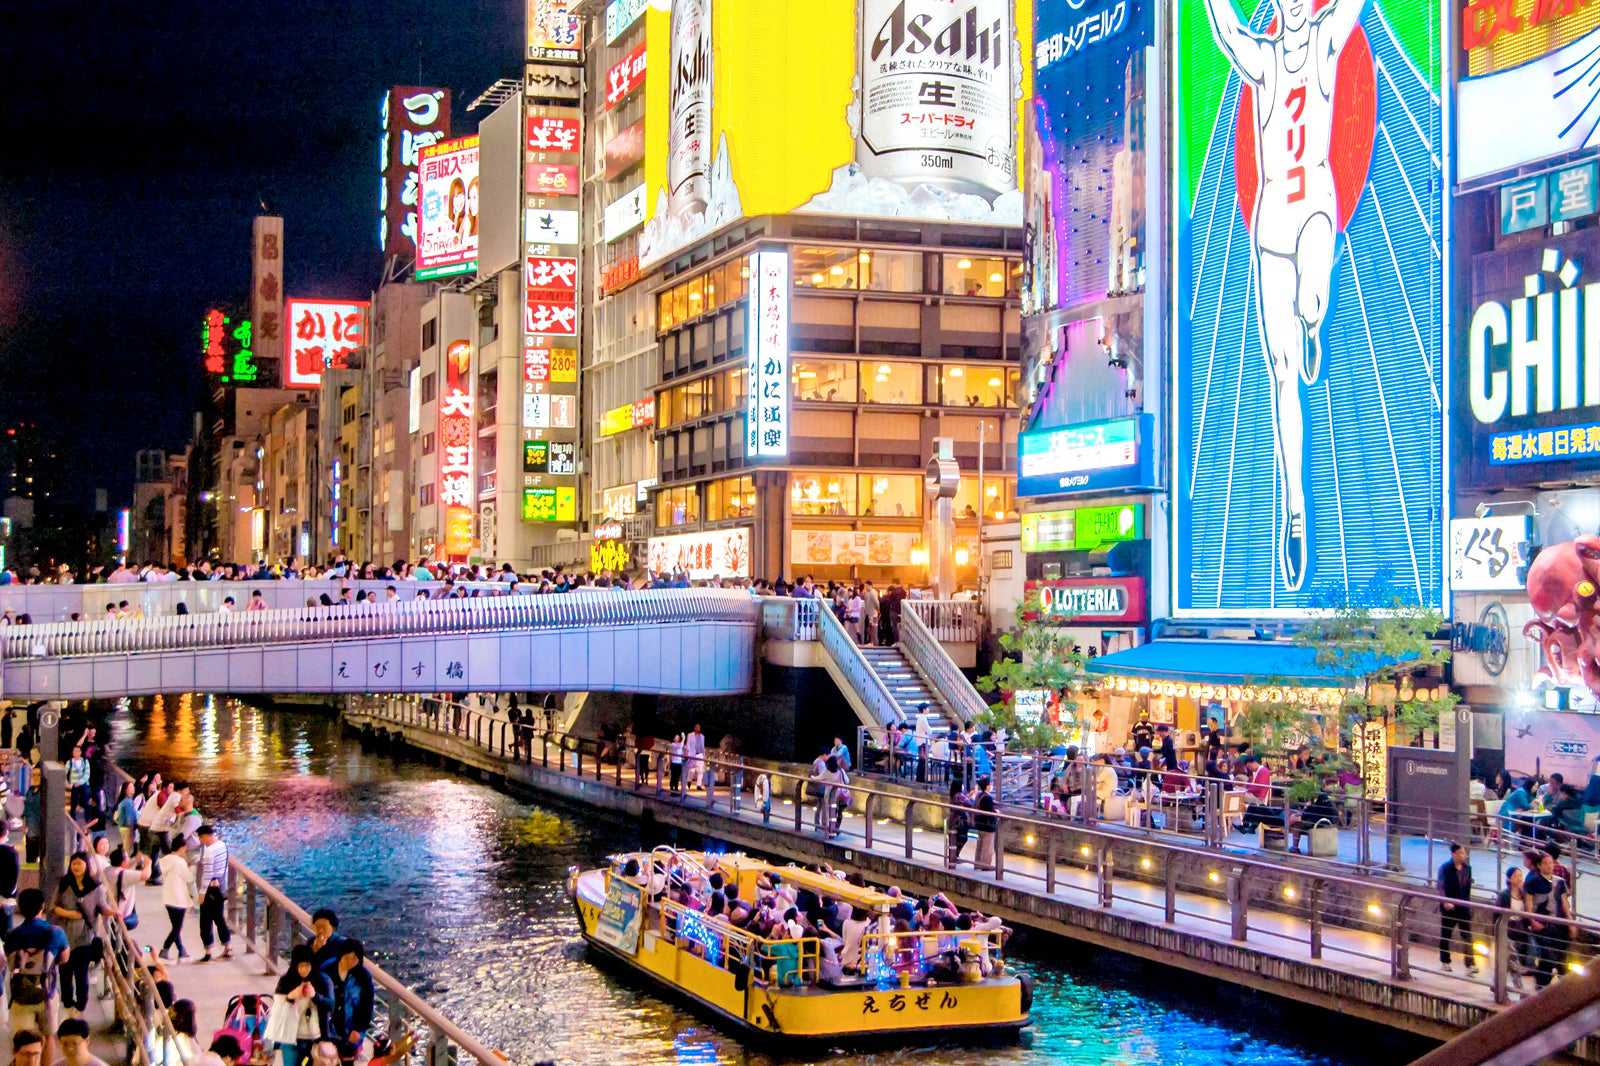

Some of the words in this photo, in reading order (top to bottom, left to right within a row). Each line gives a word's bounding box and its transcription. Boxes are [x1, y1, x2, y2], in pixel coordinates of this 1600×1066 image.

[871, 0, 1001, 70] Asahi
[918, 80, 957, 107] 生
[901, 112, 976, 130] スーパードライ
[426, 155, 462, 180] 高収入
[921, 154, 953, 169] 350ml
[1464, 527, 1510, 579] くくる
[1055, 588, 1120, 612] LOTTERIA
[338, 661, 464, 680] えびす橋
[862, 990, 958, 1015] えちぜん
